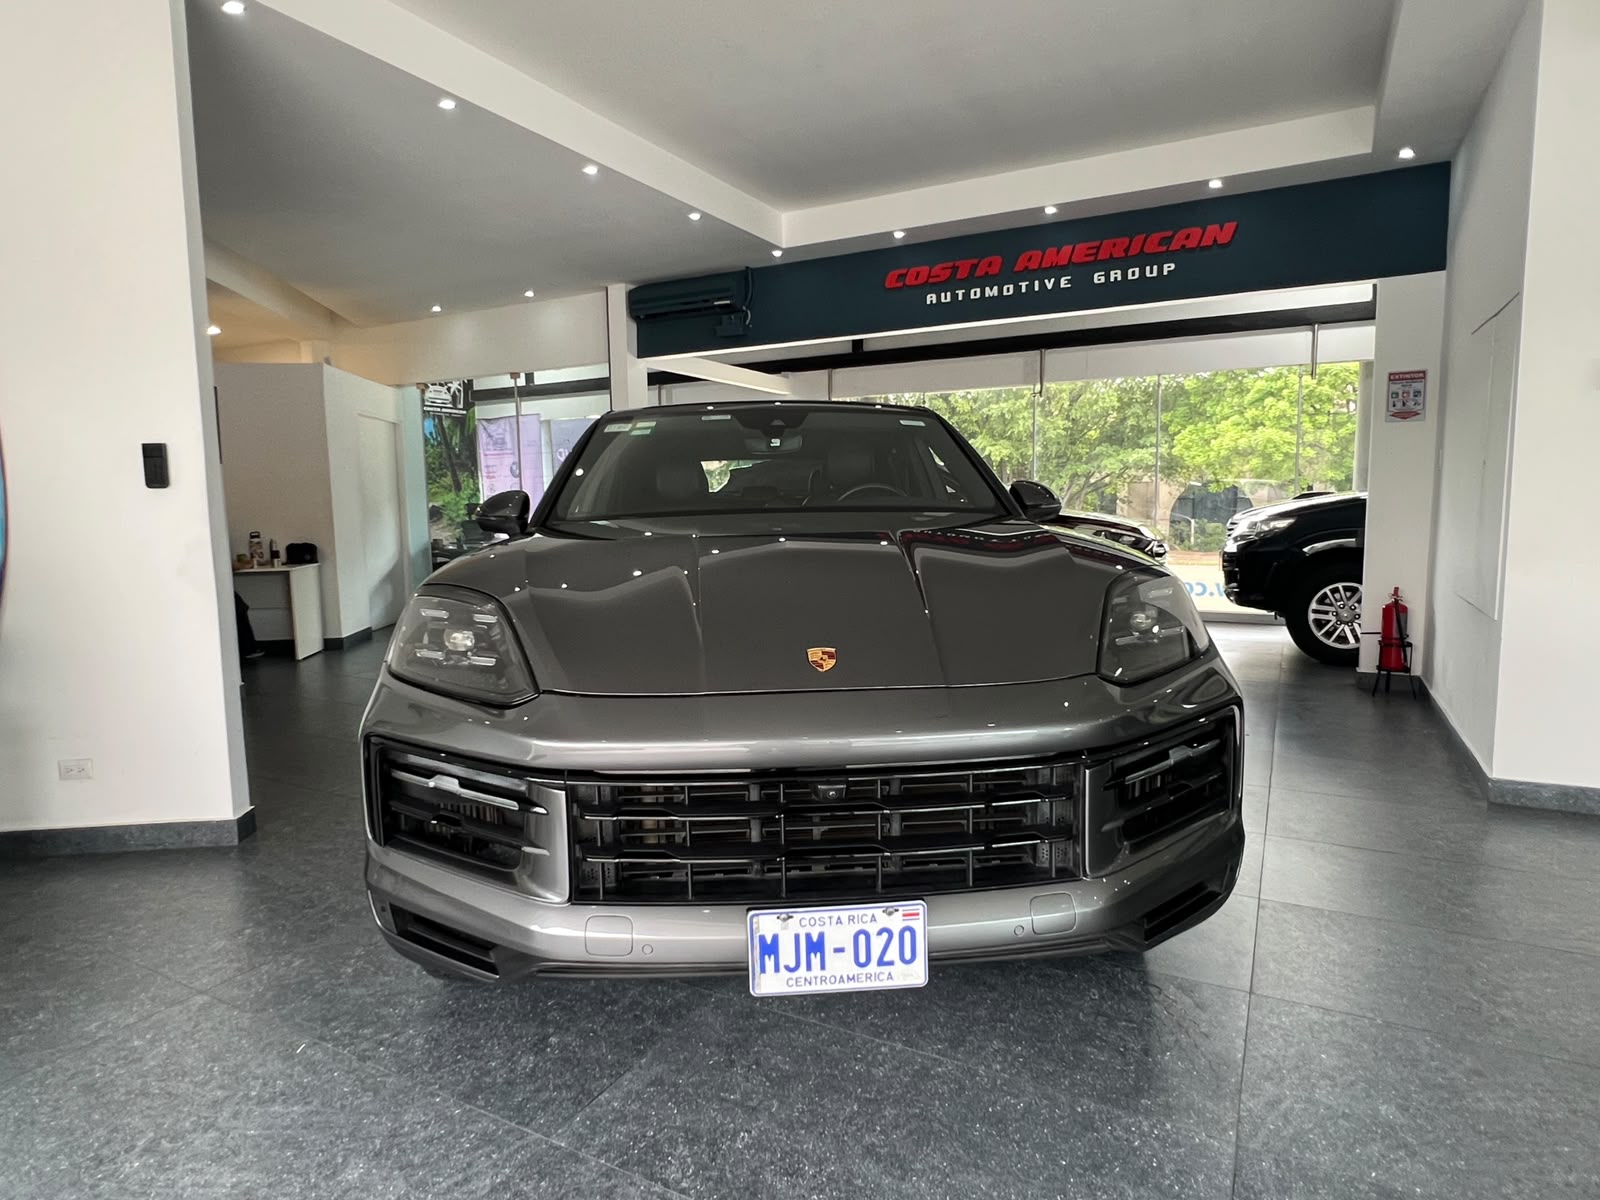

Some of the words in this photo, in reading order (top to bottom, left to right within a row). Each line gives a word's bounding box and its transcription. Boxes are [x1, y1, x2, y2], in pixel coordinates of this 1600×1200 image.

[885, 255, 1003, 289] COSTA
[1014, 222, 1239, 272] AMERICAN
[926, 276, 1073, 305] AUTOMOTIVE
[1093, 263, 1177, 284] GROUP
[799, 915, 844, 928] COSTA
[848, 913, 878, 926] RICA
[758, 926, 918, 974] MJM-020
[786, 972, 894, 988] CENTROAMERICA
